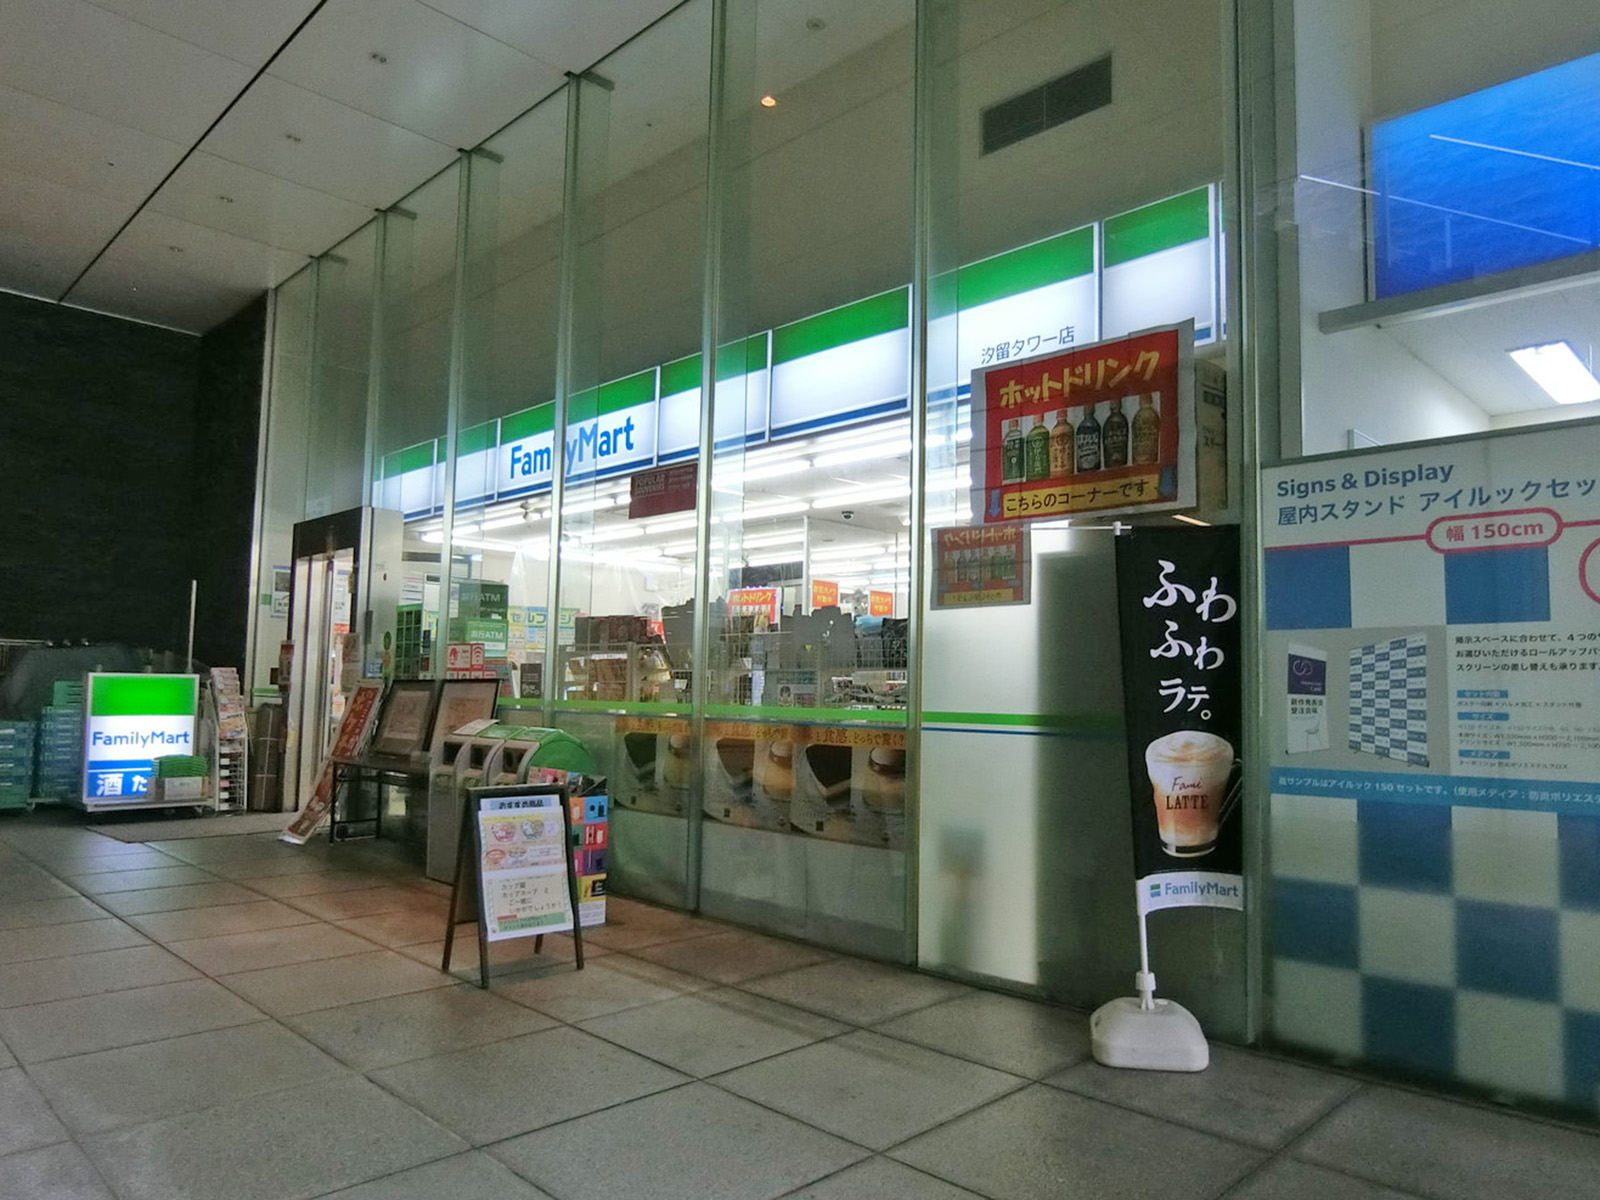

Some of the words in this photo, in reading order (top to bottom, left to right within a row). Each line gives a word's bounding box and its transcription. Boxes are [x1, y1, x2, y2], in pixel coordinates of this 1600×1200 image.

[981, 326, 1075, 364] 汐留タワー店
[1000, 350, 1159, 409] ホットドリンク
[510, 415, 634, 479] FamyMart
[1006, 478, 1150, 513] こちらのコーナーです
[1277, 476, 1336, 500] Signs
[1341, 472, 1359, 490] &
[1364, 462, 1455, 488] Display
[1277, 495, 1405, 526] 屋内スタンド
[1418, 477, 1597, 512] アイルックセッ
[1446, 525, 1464, 542] 幅
[1471, 521, 1544, 539] 150cm
[1142, 559, 1237, 623] ふわ
[1149, 619, 1225, 671] ふわ
[1158, 677, 1212, 720] ラテ。
[92, 730, 190, 748] FamilyMart
[96, 773, 124, 796] 酒
[1166, 794, 1209, 810] LATTE
[1375, 783, 1394, 791] 150
[1165, 881, 1239, 898] FamilyMart
